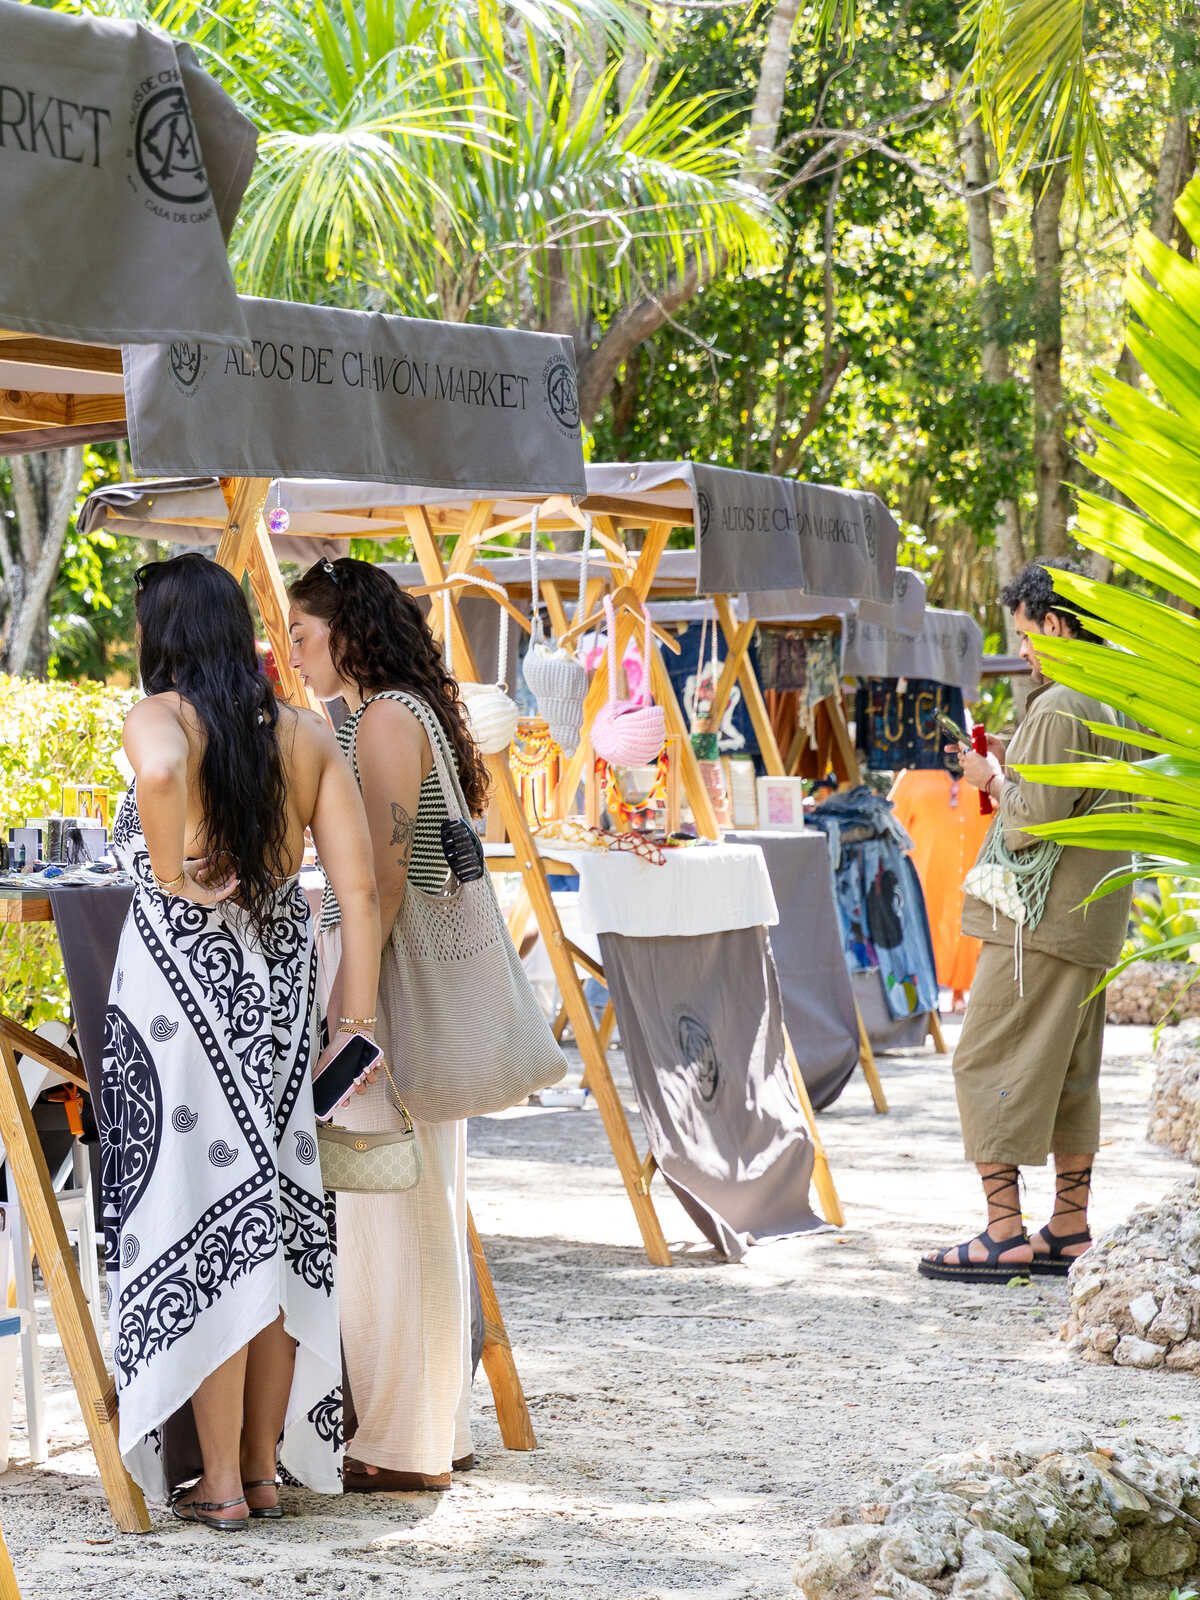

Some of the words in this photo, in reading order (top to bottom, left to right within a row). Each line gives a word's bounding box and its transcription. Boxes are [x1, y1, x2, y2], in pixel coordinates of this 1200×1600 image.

[173, 212, 188, 223] DE
[224, 339, 295, 380] ALTOS
[301, 346, 334, 385] DE
[341, 352, 429, 398] CHAVÓN
[434, 364, 530, 411] MARKET
[721, 506, 755, 532] ALTOS
[757, 507, 770, 532] DE
